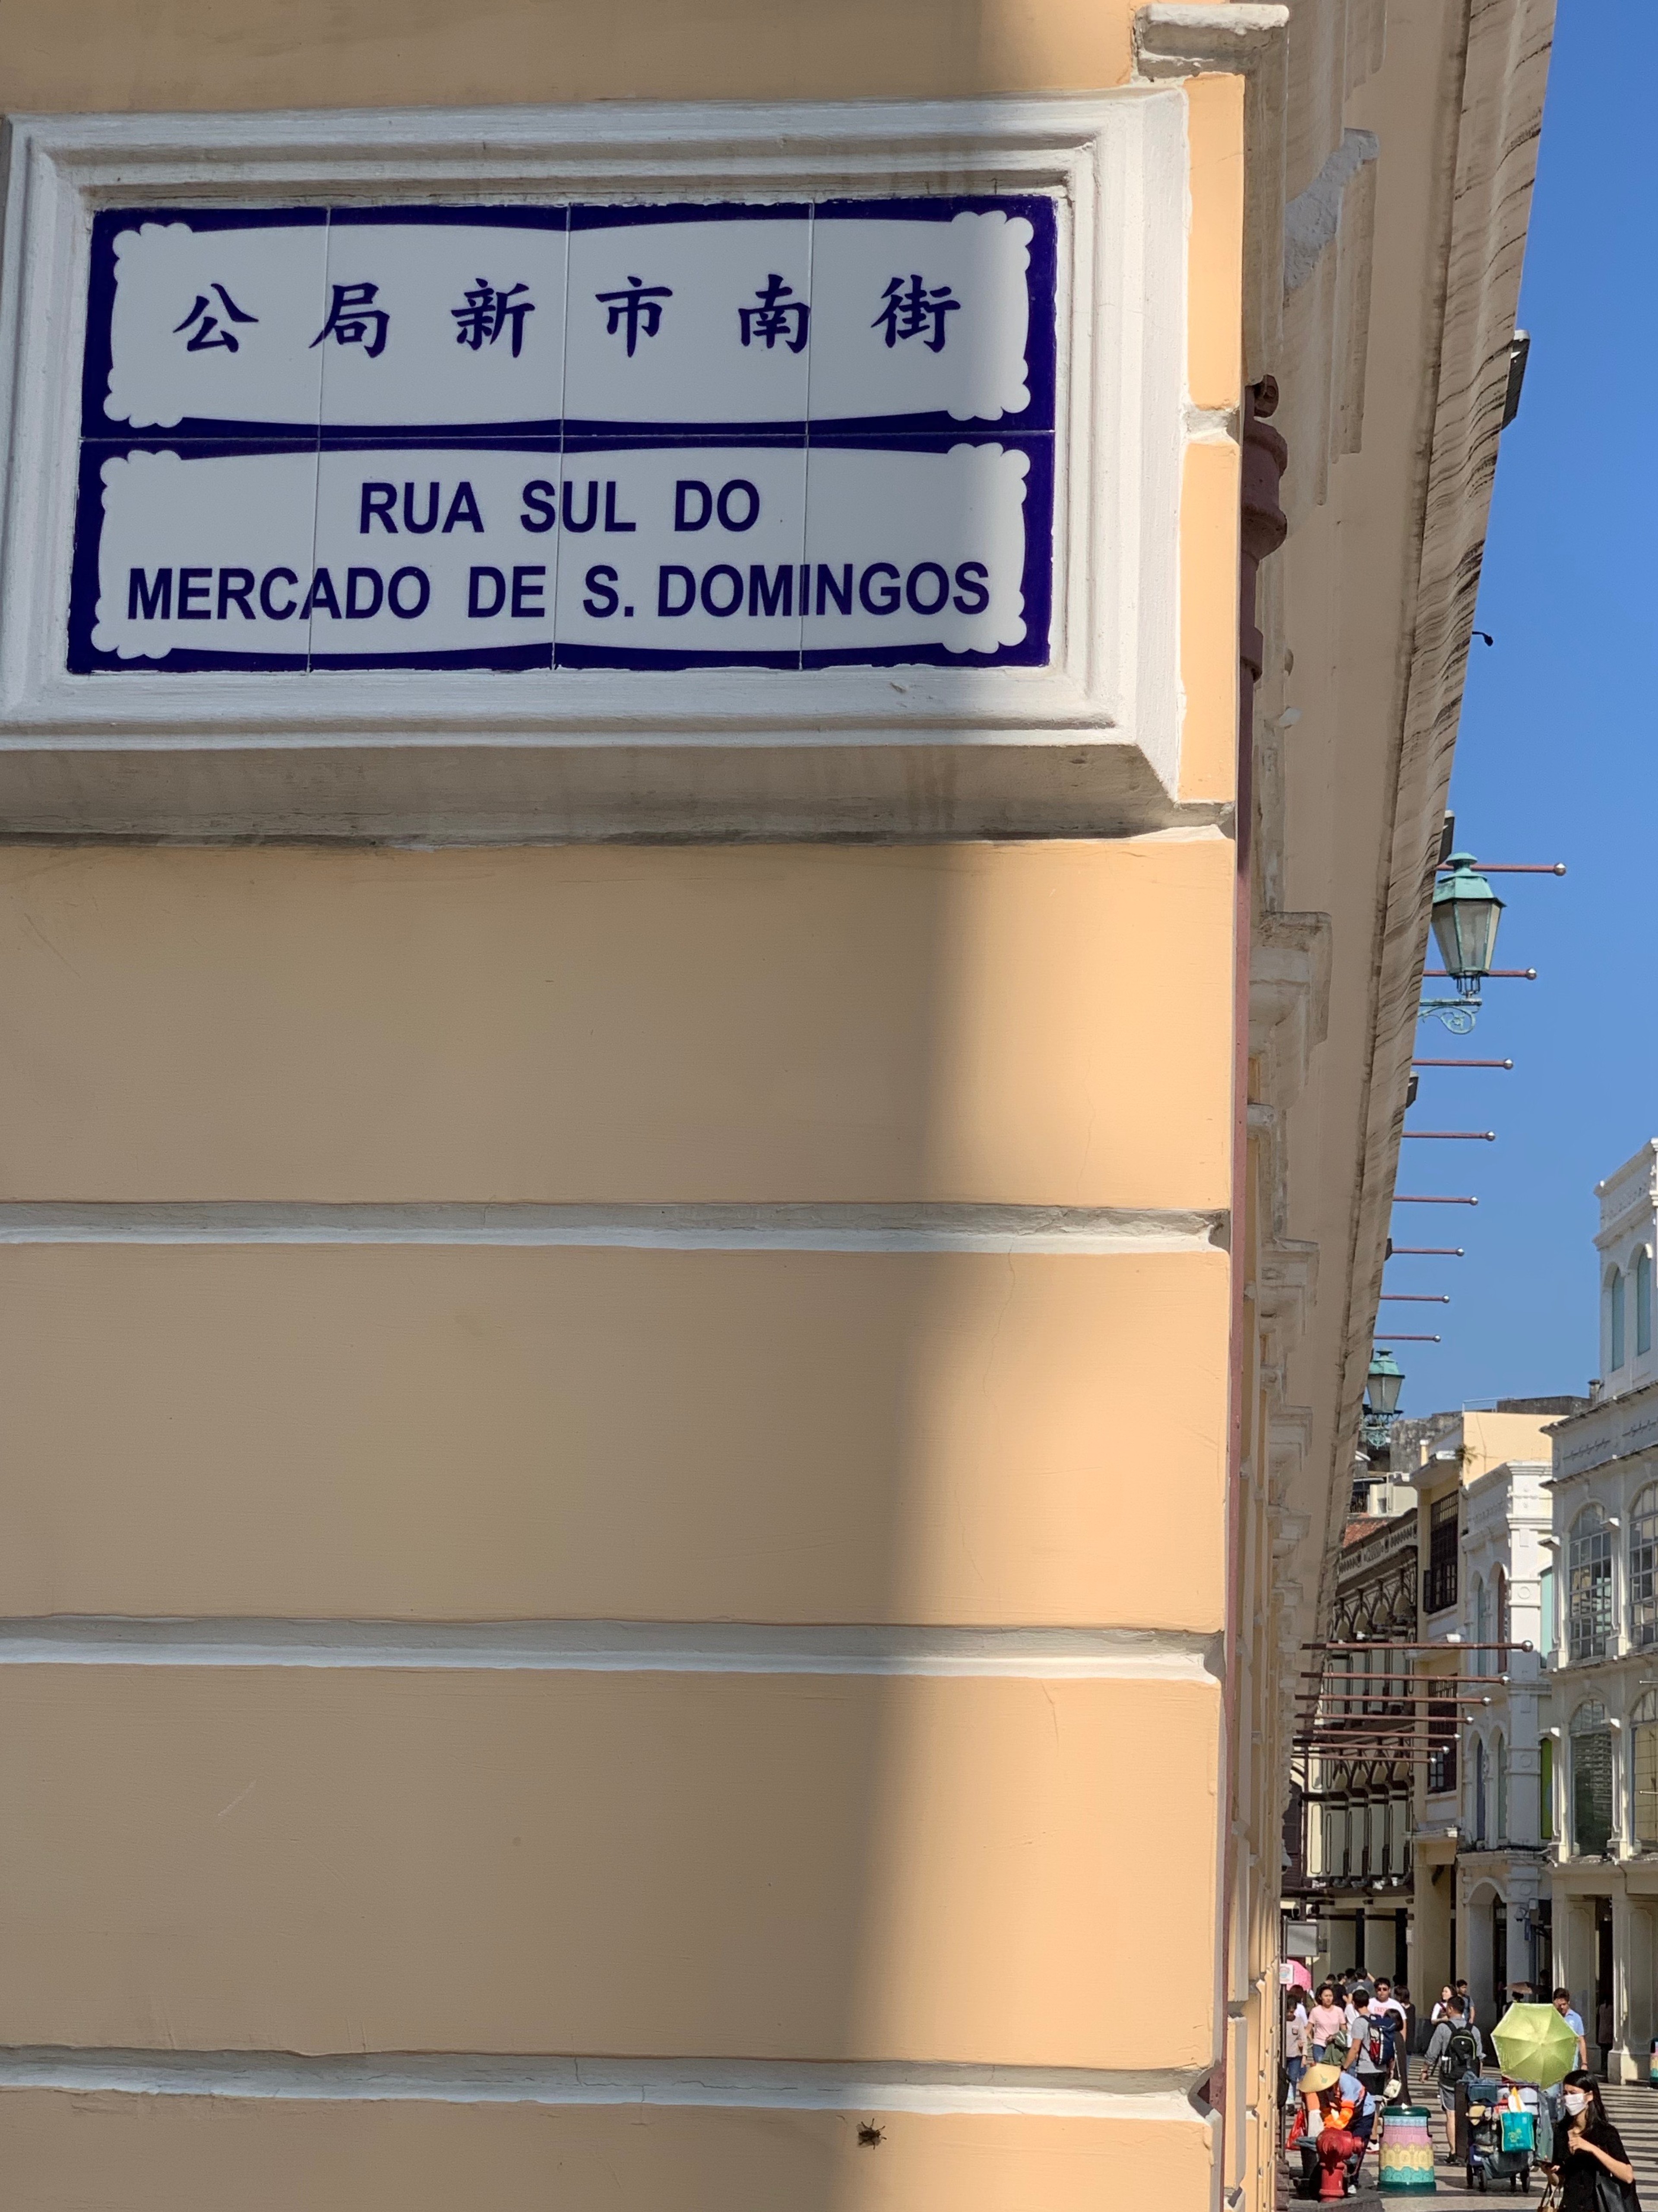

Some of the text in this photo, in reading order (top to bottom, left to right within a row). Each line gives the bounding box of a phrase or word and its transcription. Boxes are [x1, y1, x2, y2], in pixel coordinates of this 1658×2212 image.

[173, 274, 961, 358] 公局新市南街
[359, 479, 760, 534] RUA SUL DO
[127, 561, 990, 620] MERCADO DE S. DOMINGOS
